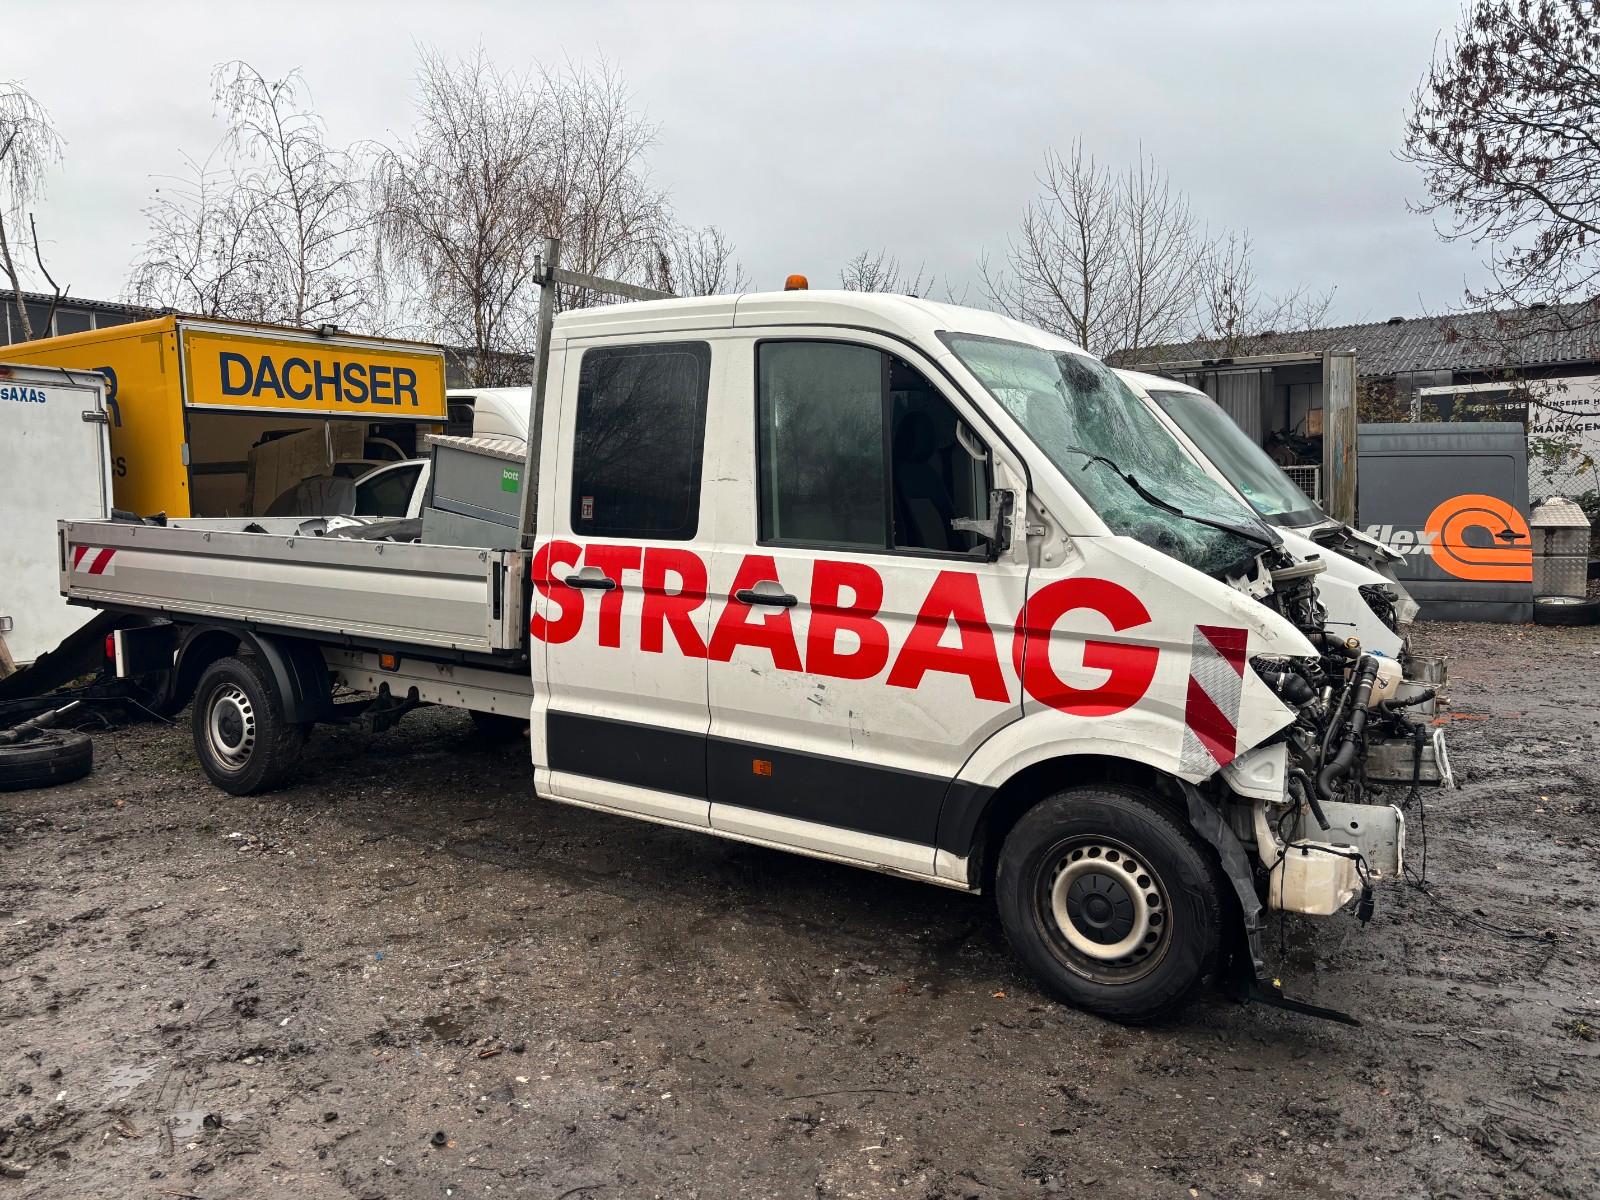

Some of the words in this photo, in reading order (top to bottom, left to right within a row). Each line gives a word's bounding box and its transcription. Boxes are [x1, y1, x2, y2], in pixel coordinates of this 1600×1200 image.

[219, 351, 419, 407] DACHSER
[1546, 399, 1590, 407] UNSERER
[503, 469, 519, 480] bott
[1363, 525, 1439, 554] flex
[530, 539, 1159, 717] STRABAG
